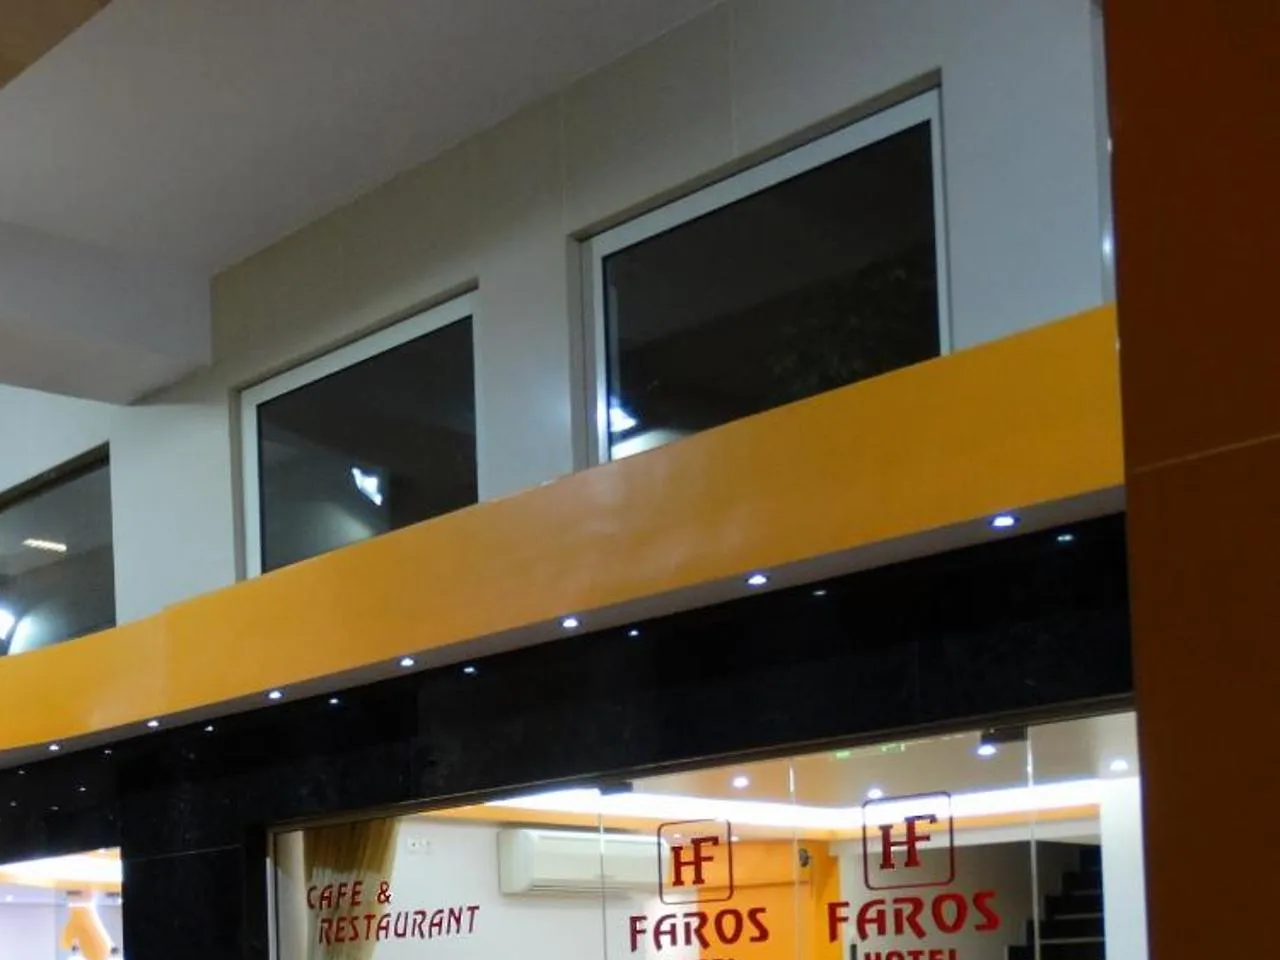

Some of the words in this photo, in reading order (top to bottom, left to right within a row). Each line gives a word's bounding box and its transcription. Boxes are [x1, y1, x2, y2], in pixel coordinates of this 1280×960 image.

[306, 881, 363, 911] CAFE
[376, 880, 392, 905] &
[827, 891, 1002, 943] FAROS
[319, 905, 480, 946] RESTAURANT
[629, 907, 770, 952] FAROS
